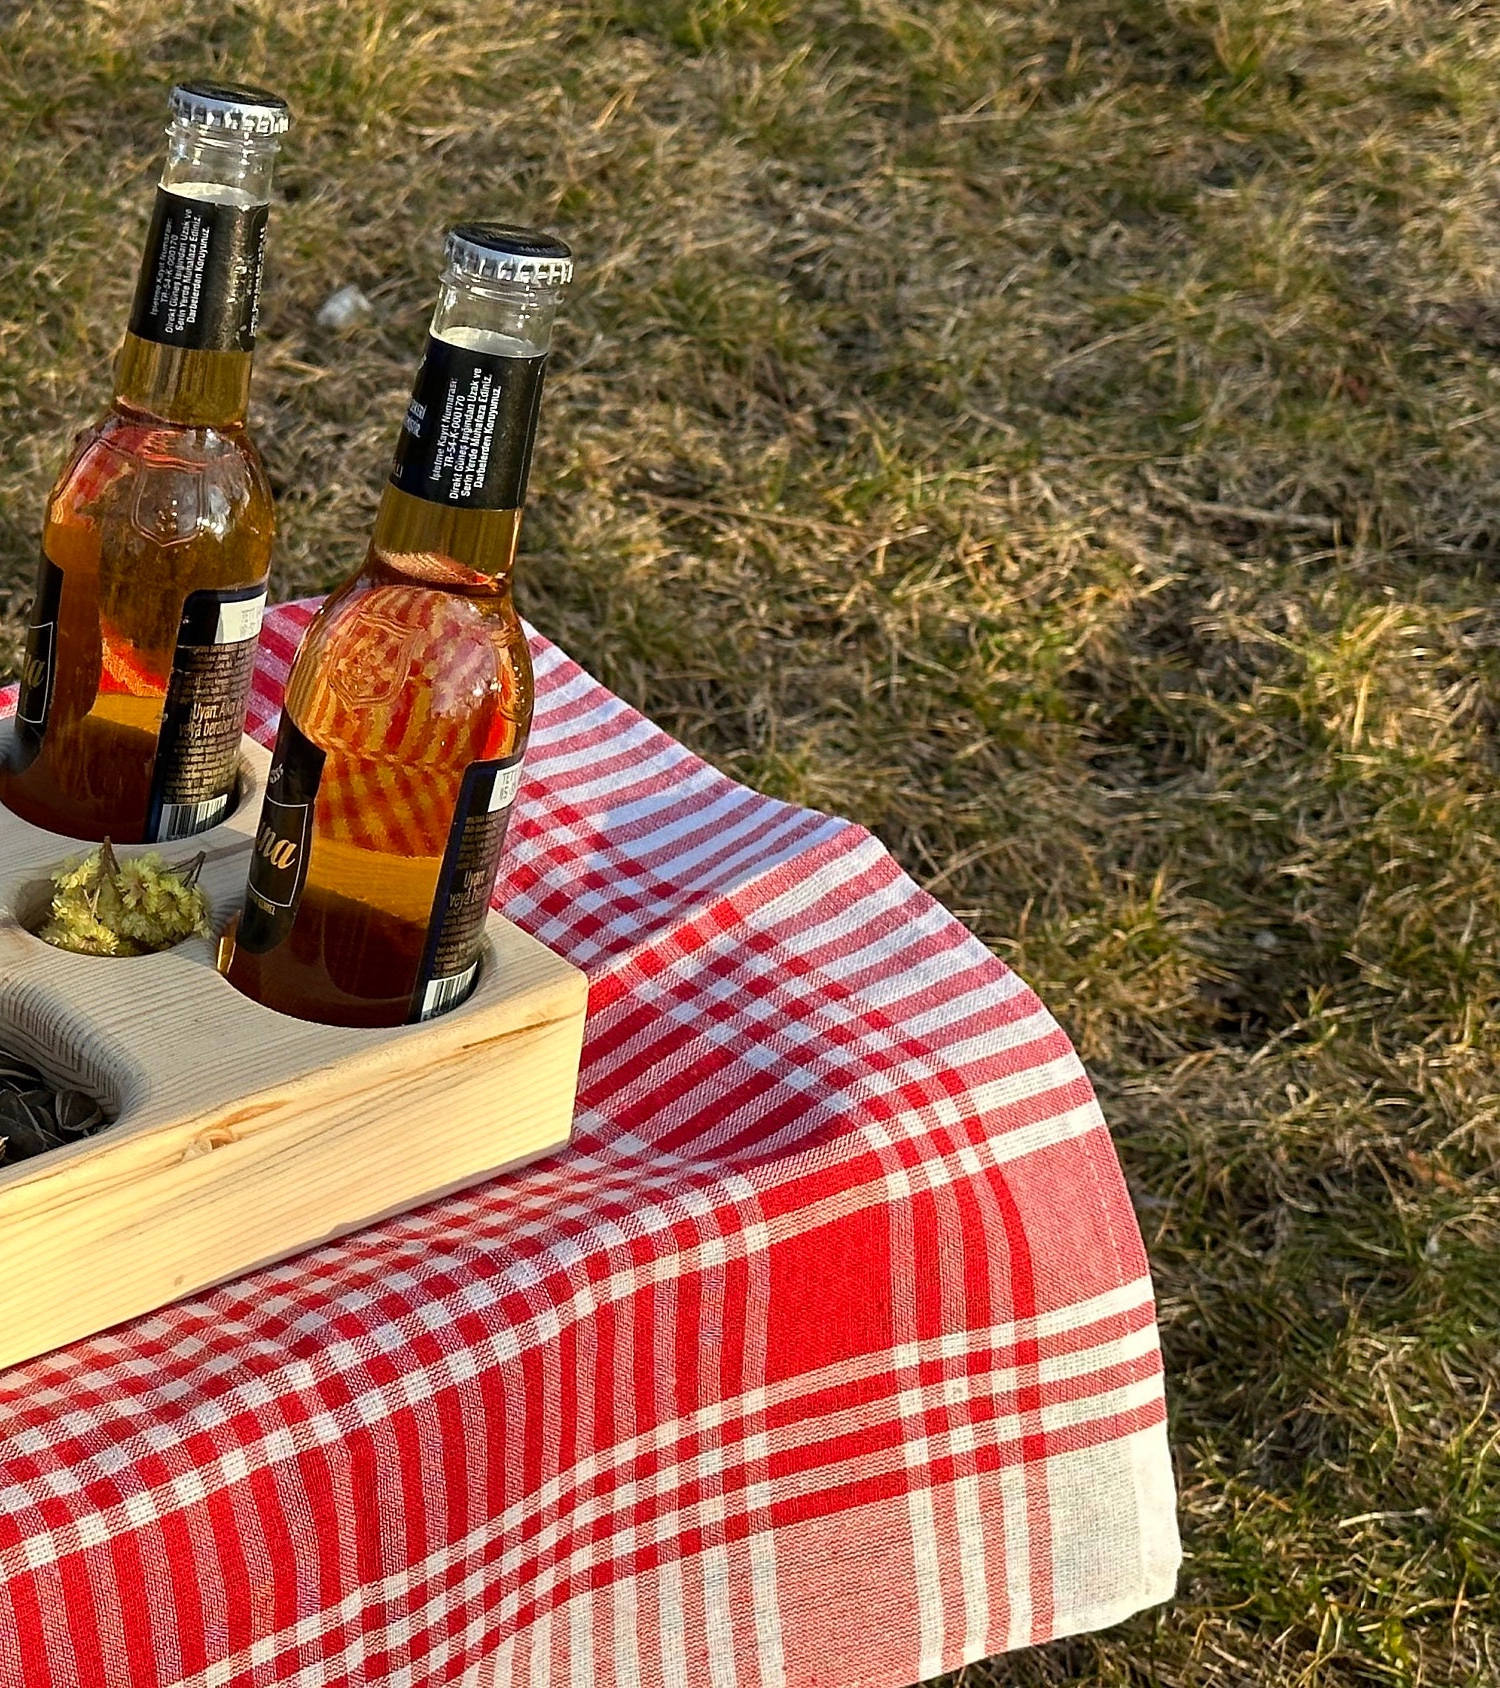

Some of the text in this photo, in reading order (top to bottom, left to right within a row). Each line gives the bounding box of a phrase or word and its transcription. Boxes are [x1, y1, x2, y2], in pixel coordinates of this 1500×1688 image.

[185, 208, 192, 219] ve
[473, 367, 481, 378] ve
[468, 380, 479, 402] Uzak
[444, 395, 465, 468] TR-54-K-000170
[471, 404, 486, 446] Muhafaza
[474, 384, 502, 488] Darbelerden Koruyunuz.
[455, 444, 469, 472] Güneş
[466, 448, 478, 473] Yerde
[449, 473, 462, 499] Direkt
[461, 474, 473, 497] Serin
